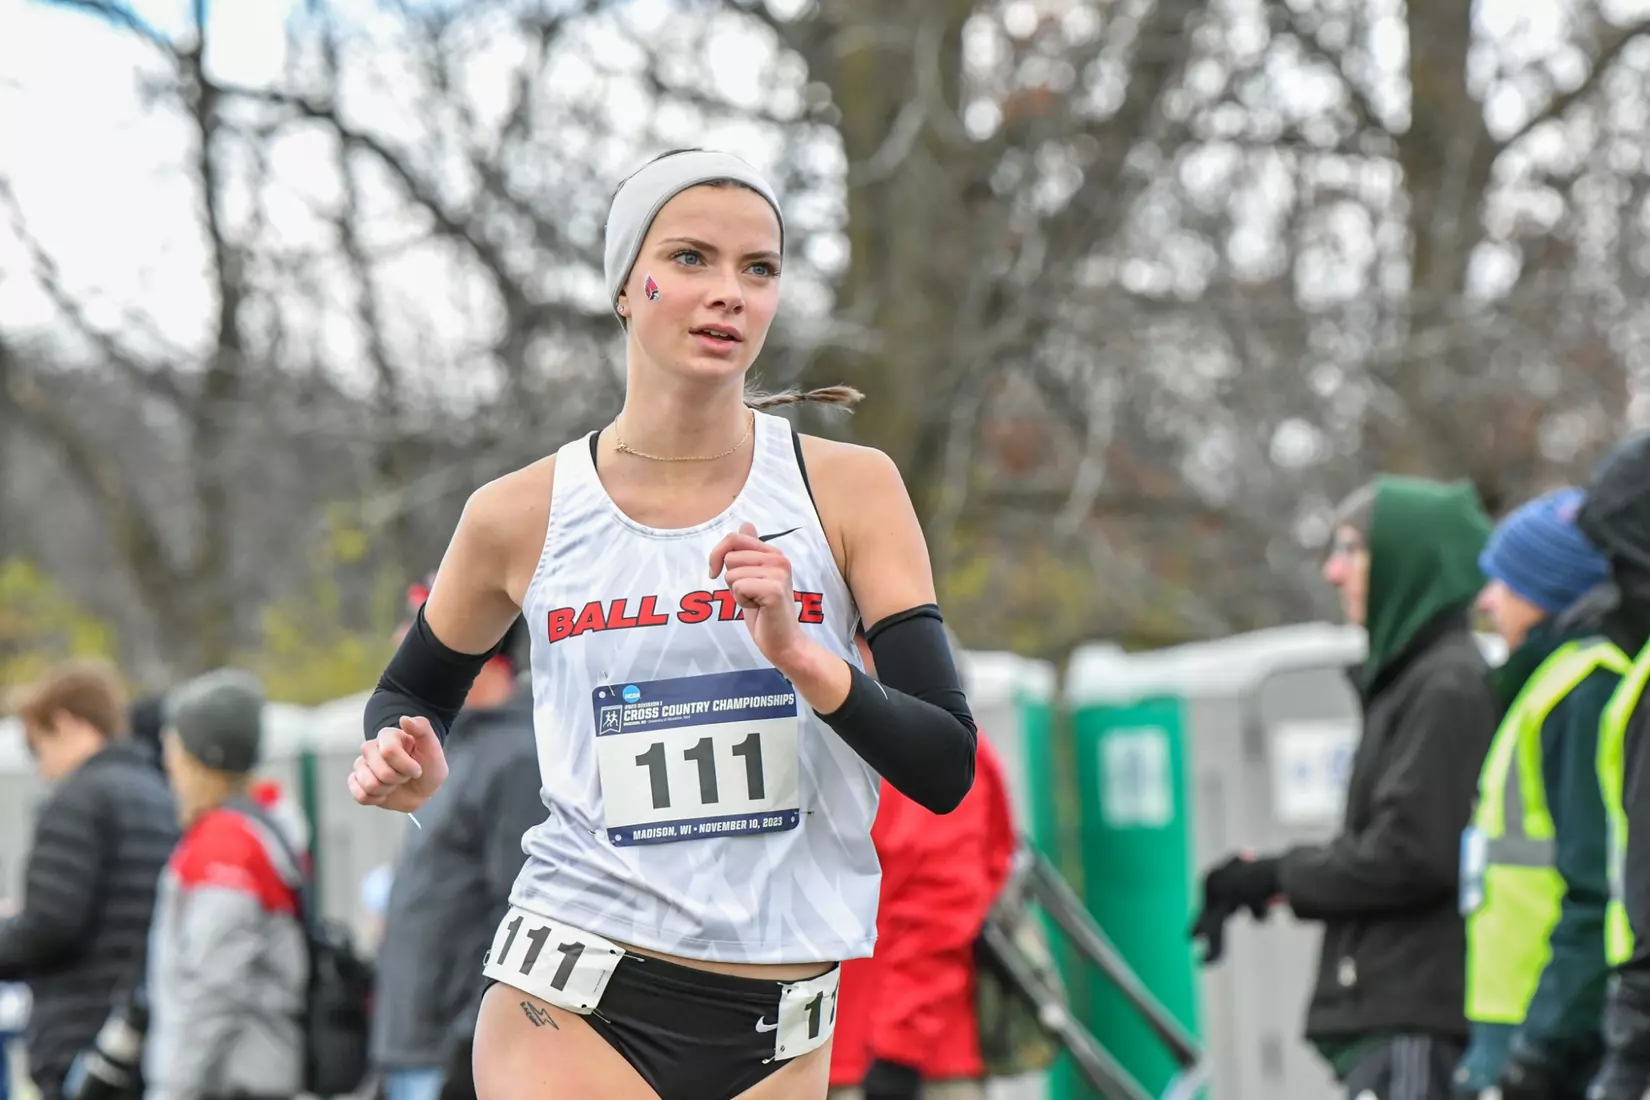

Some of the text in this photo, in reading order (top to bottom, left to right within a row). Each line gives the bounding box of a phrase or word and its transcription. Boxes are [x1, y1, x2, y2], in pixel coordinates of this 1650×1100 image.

[548, 589, 824, 643] BALL STE
[623, 693, 795, 722] CROSS COUNTRY CHAMPIONSHIPS
[635, 733, 765, 810] 111
[632, 816, 783, 841] MADISON, WI NOVEMBER 10, 2023
[497, 916, 586, 991] 111
